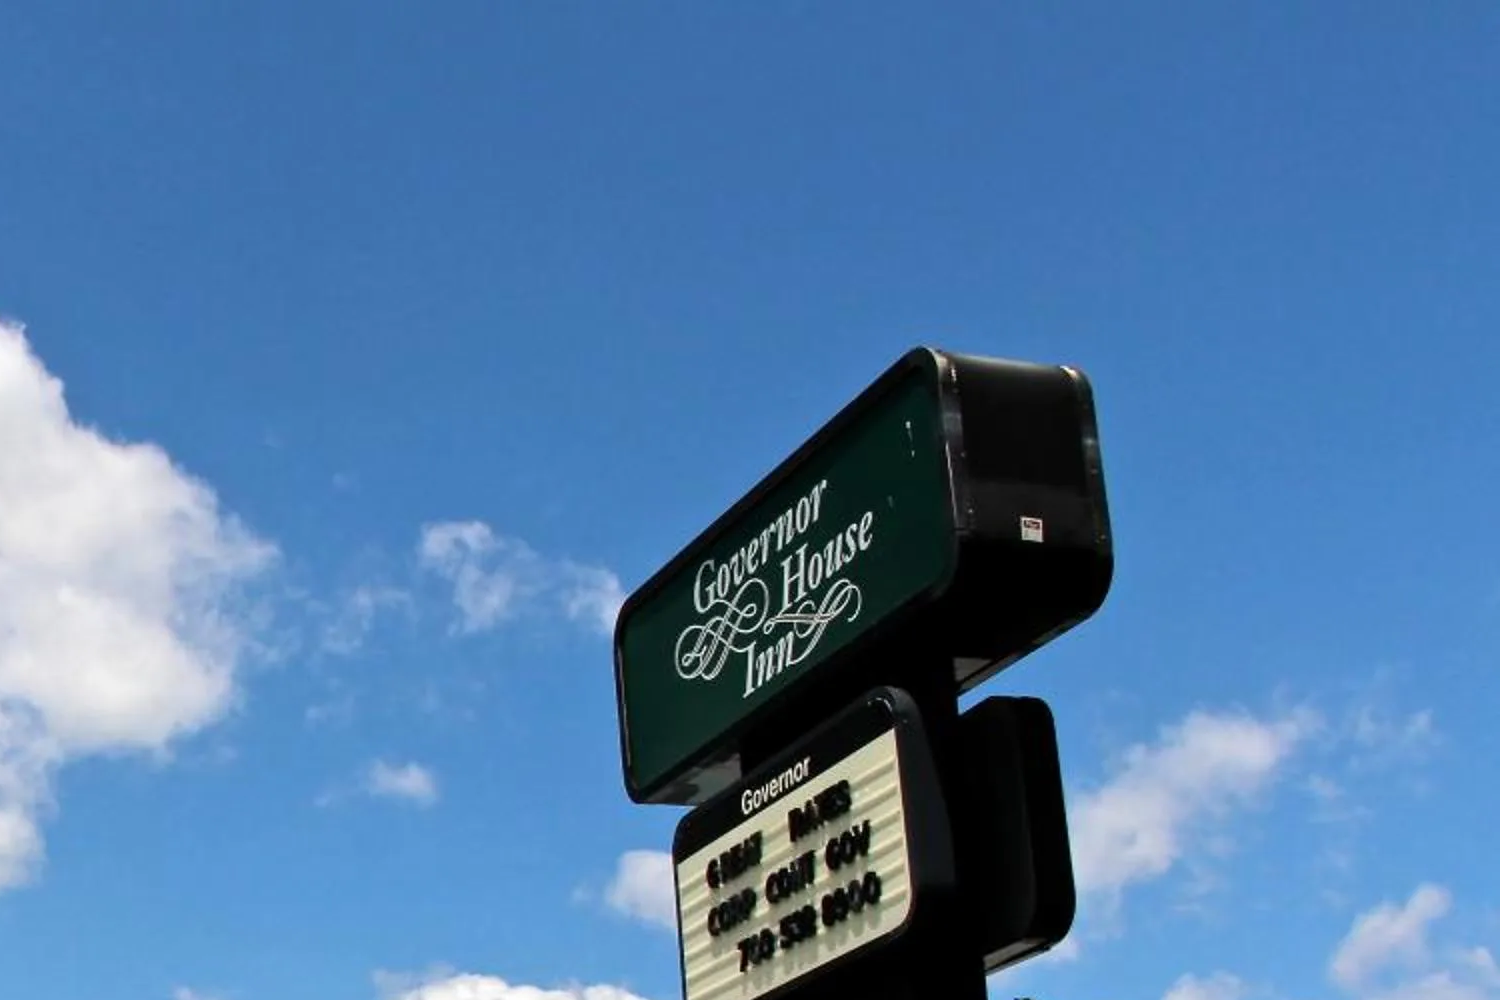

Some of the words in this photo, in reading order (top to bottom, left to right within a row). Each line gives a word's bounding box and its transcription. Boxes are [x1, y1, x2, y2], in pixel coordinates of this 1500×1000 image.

[693, 479, 828, 614] Governor
[779, 511, 874, 613] House
[742, 631, 796, 699] Inn
[741, 755, 811, 815] Governor
